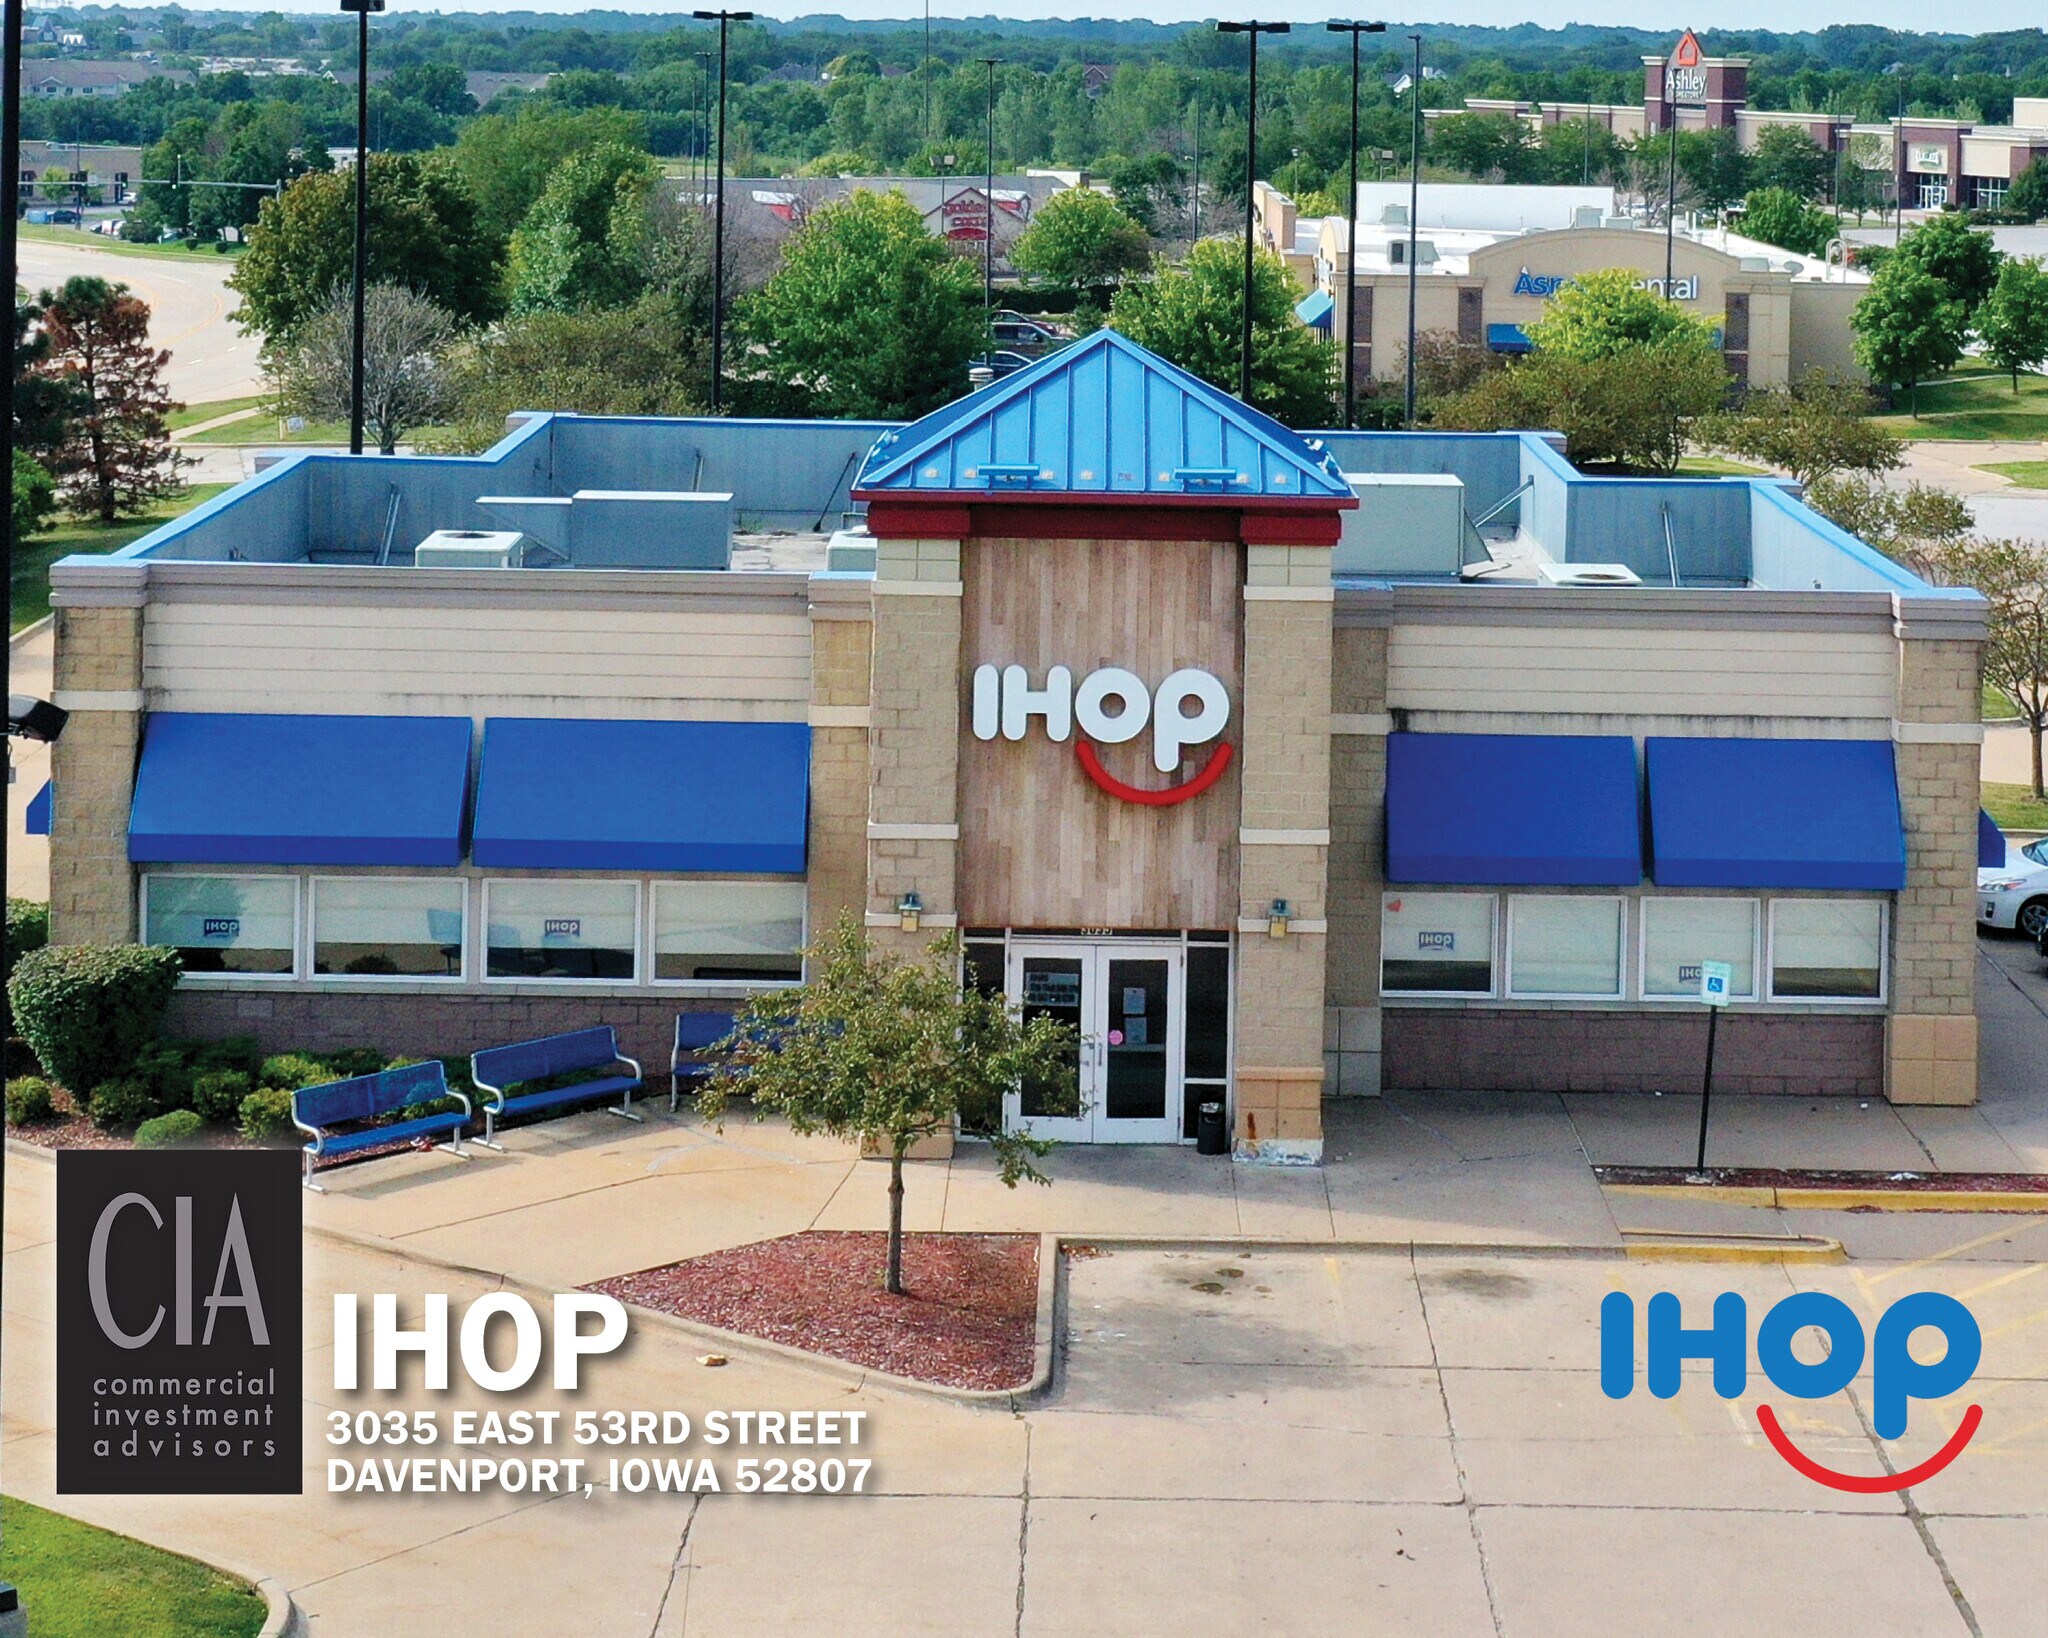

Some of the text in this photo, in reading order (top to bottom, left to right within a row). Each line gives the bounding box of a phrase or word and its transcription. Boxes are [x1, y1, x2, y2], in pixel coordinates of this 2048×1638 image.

[1665, 69, 1706, 97] Ashley
[973, 664, 1230, 772] IHOP
[206, 921, 238, 933] IHOP
[546, 921, 578, 933] IHOP
[1420, 933, 1452, 946] IHOP
[1681, 967, 1702, 978] IHO
